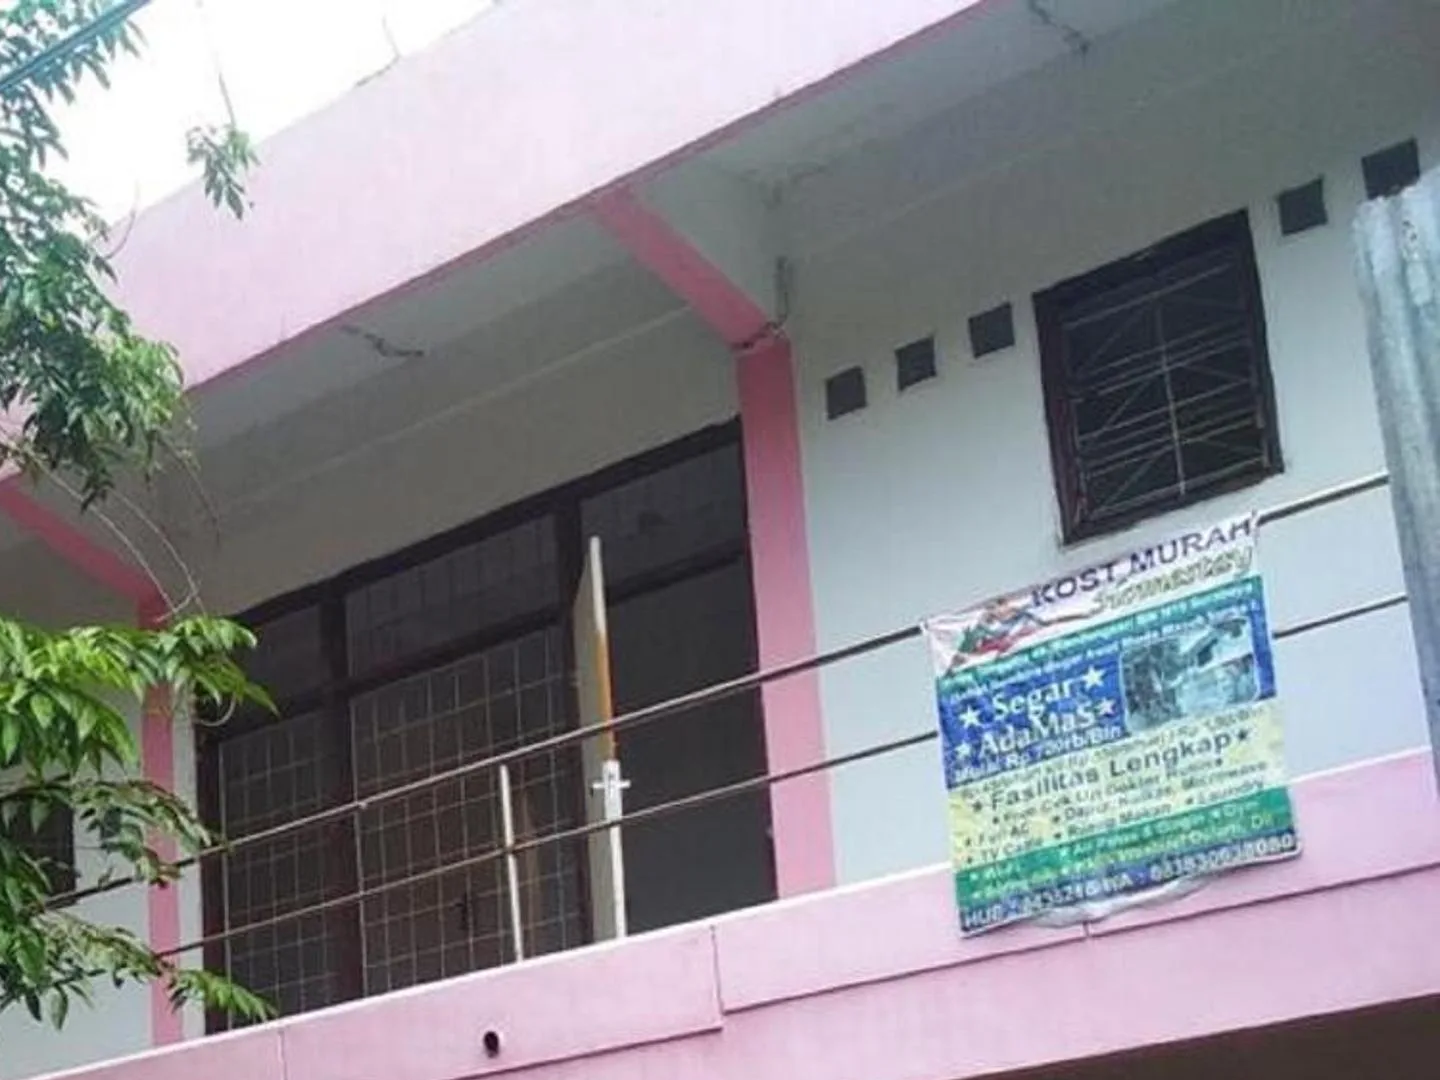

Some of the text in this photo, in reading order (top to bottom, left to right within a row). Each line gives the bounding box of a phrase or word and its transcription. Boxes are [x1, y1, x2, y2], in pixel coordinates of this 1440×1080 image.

[1032, 518, 1252, 606] KOST MURAH
[992, 680, 1073, 719] Segar
[991, 768, 1099, 811] Fasilitas
[1110, 732, 1231, 777] Lengkap
